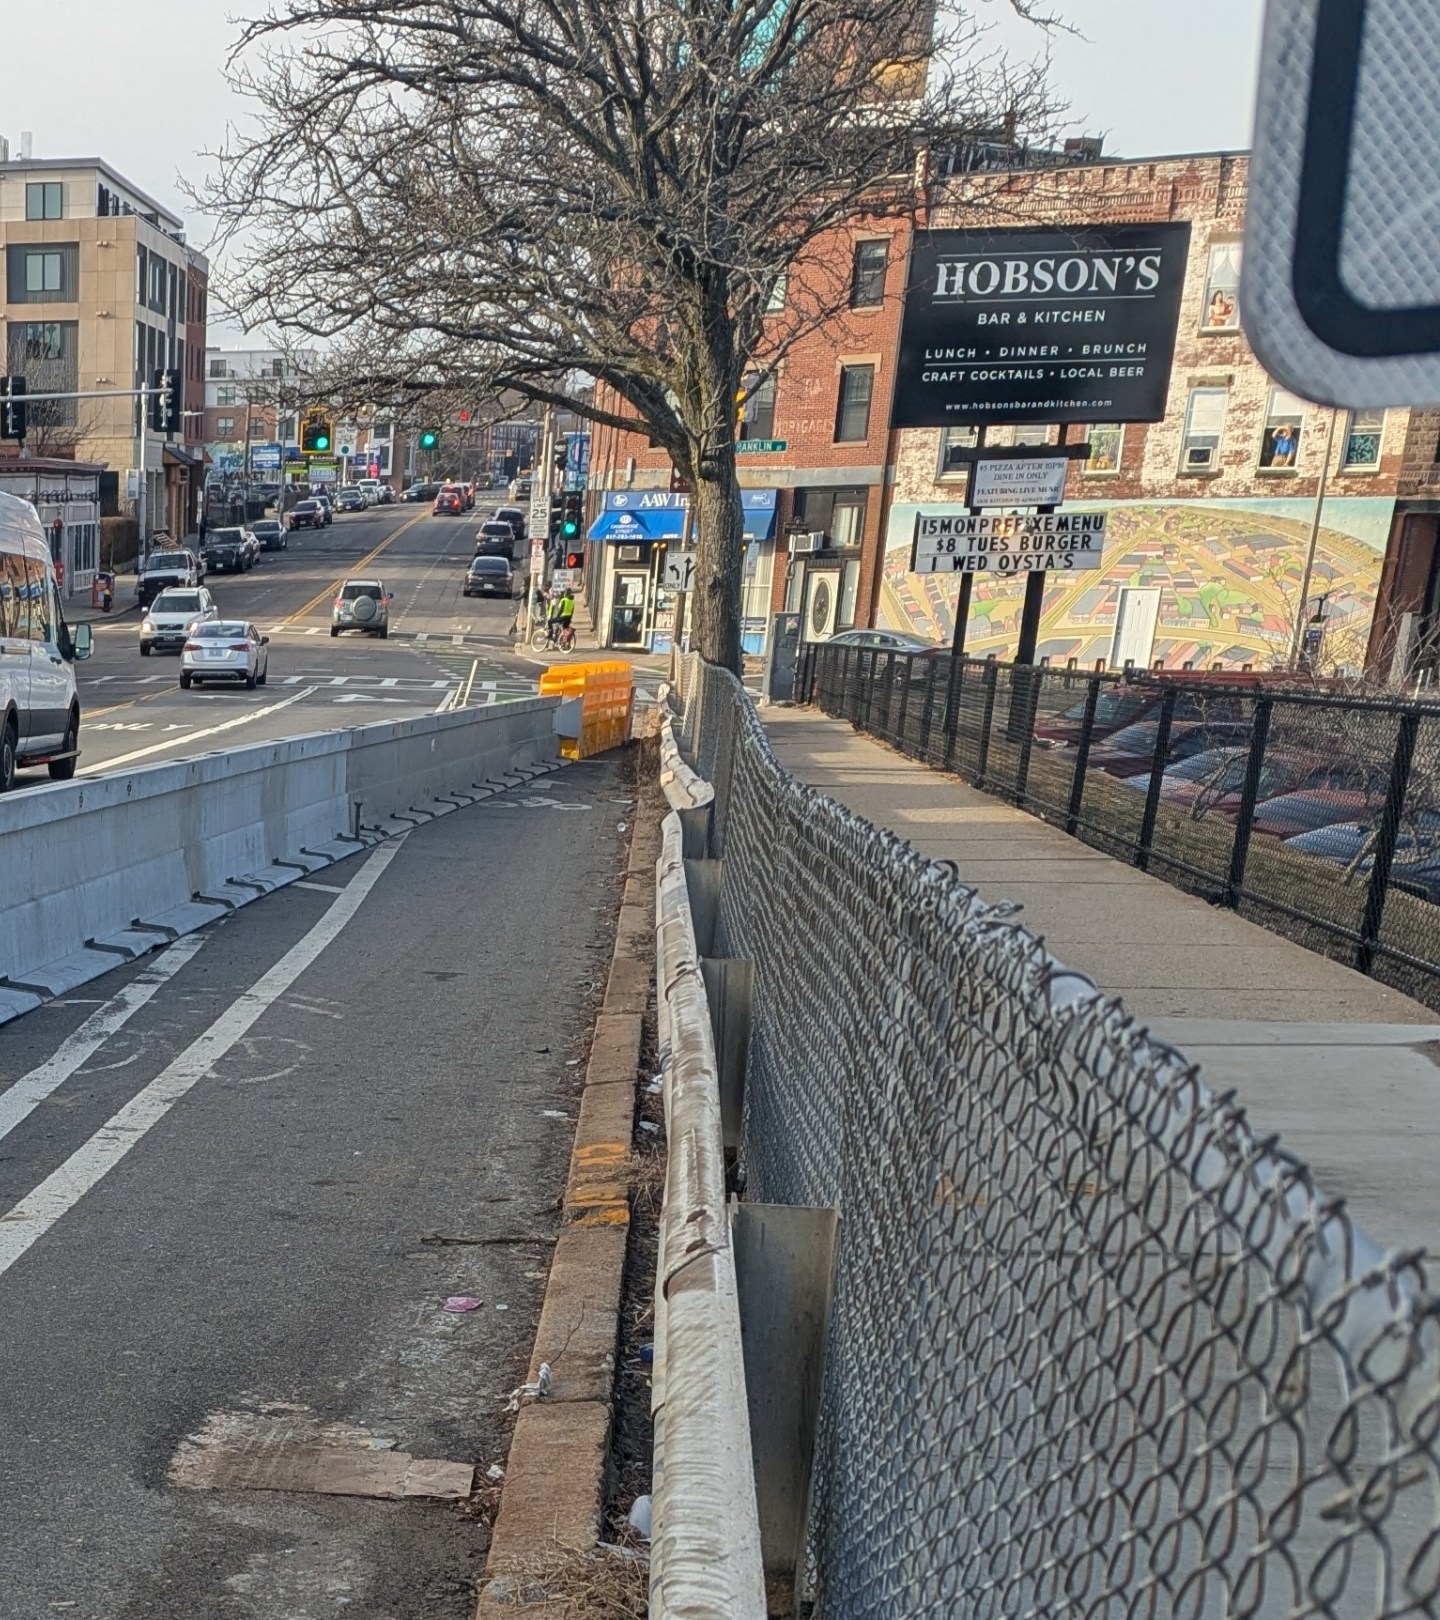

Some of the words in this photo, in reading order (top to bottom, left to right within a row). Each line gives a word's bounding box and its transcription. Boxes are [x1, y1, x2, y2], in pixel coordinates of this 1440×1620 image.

[932, 255, 1162, 296] HOBSON'S
[977, 312, 1011, 325] BAR
[1017, 312, 1027, 324] &
[1034, 310, 1106, 323] KITCHEN
[925, 348, 976, 359] LUNCH
[999, 345, 1059, 357] DINNER
[1081, 343, 1147, 355] BRUNCH
[922, 371, 965, 382] CRAFT
[970, 369, 1044, 381] COCKTAILS
[1060, 367, 1103, 379] LOCAL
[1109, 366, 1144, 377] BEER
[945, 399, 1112, 410] www.hobsonsbarandkitchen.com
[989, 463, 1013, 472] PIZZA
[1015, 462, 1043, 471] AFTER
[993, 472, 1013, 481] DINE
[1015, 472, 1025, 480] IN
[1026, 472, 1048, 480] ONLY
[977, 487, 1018, 495] FEATURING
[1019, 486, 1036, 494] LIVE
[639, 493, 672, 507] AAW
[531, 508, 547, 519] 25
[936, 537, 957, 553] $8
[967, 536, 1010, 552] TUES
[1019, 535, 1092, 551] BURGER
[953, 555, 988, 571] WED
[998, 553, 1075, 569] OYSTA'S
